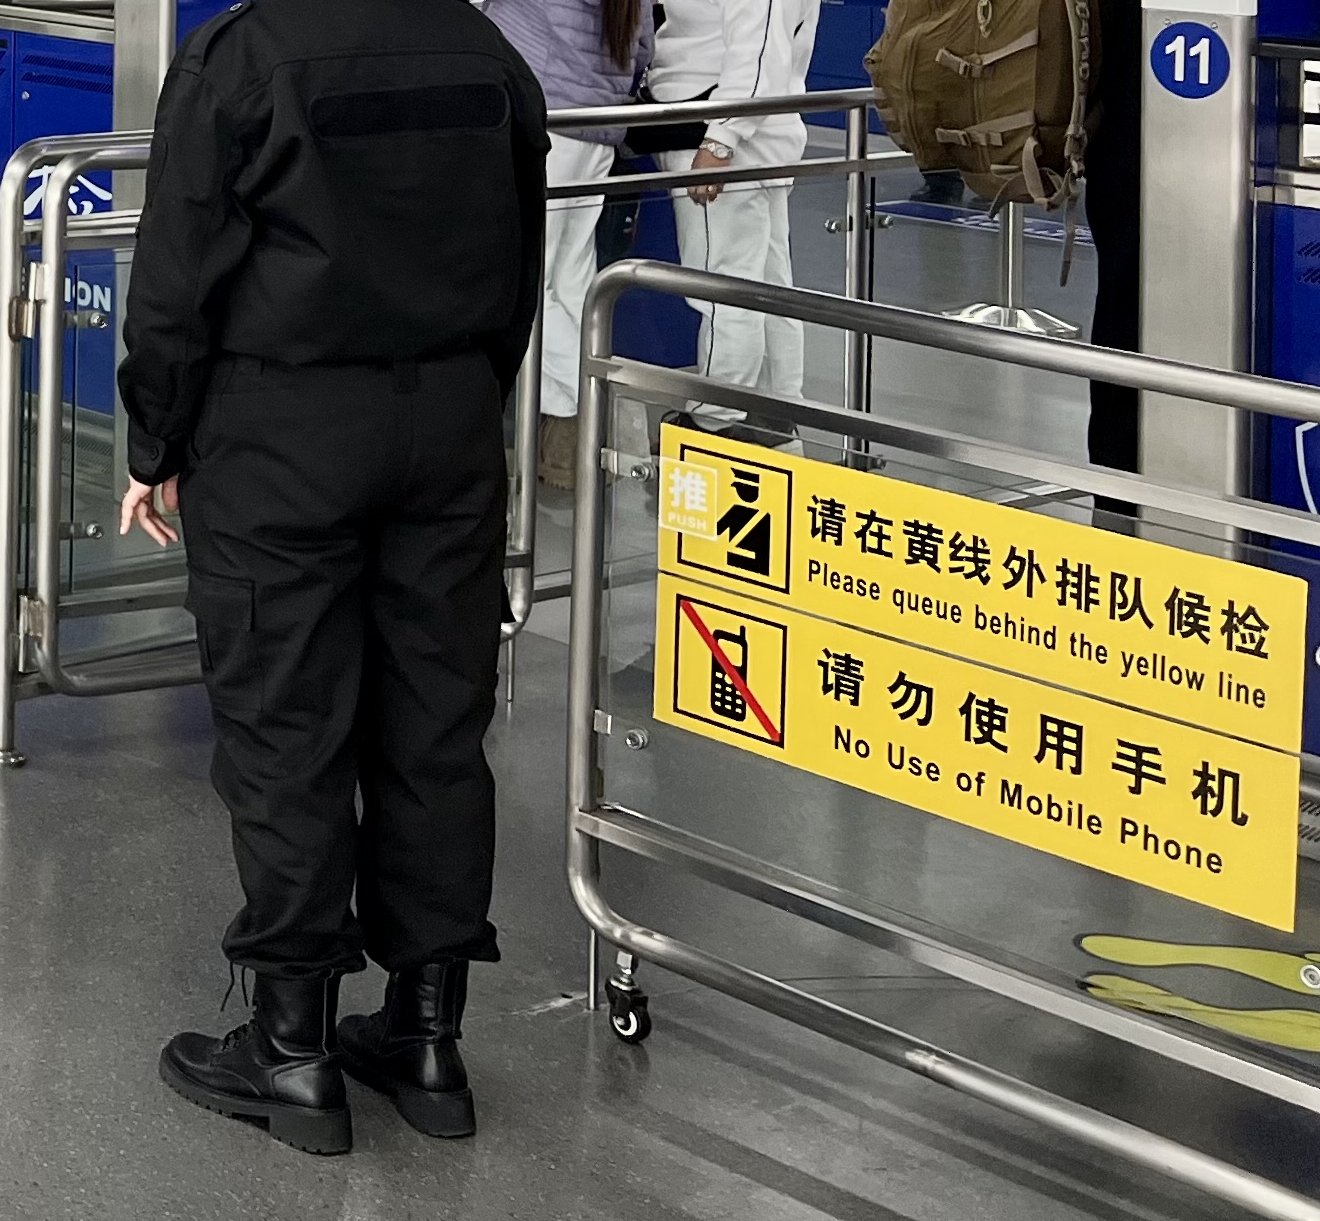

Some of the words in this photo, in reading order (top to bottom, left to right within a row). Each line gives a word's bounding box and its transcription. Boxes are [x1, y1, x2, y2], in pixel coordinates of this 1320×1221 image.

[1165, 35, 1210, 84] 11
[668, 466, 708, 512] 推
[668, 512, 707, 531] PUSH
[806, 494, 1270, 660] 请在黄线外排队候检
[808, 559, 881, 601] Please
[892, 588, 962, 624] queue
[975, 604, 1057, 651] behind
[1070, 632, 1108, 665] the
[1121, 651, 1205, 691] yellow
[1218, 671, 1266, 709] line
[817, 647, 1249, 827] 请勿使用手机
[834, 724, 870, 759] No
[887, 742, 941, 782] Use
[956, 771, 986, 797] of
[1000, 779, 1103, 835] Mobile
[1120, 817, 1223, 874] Phone
